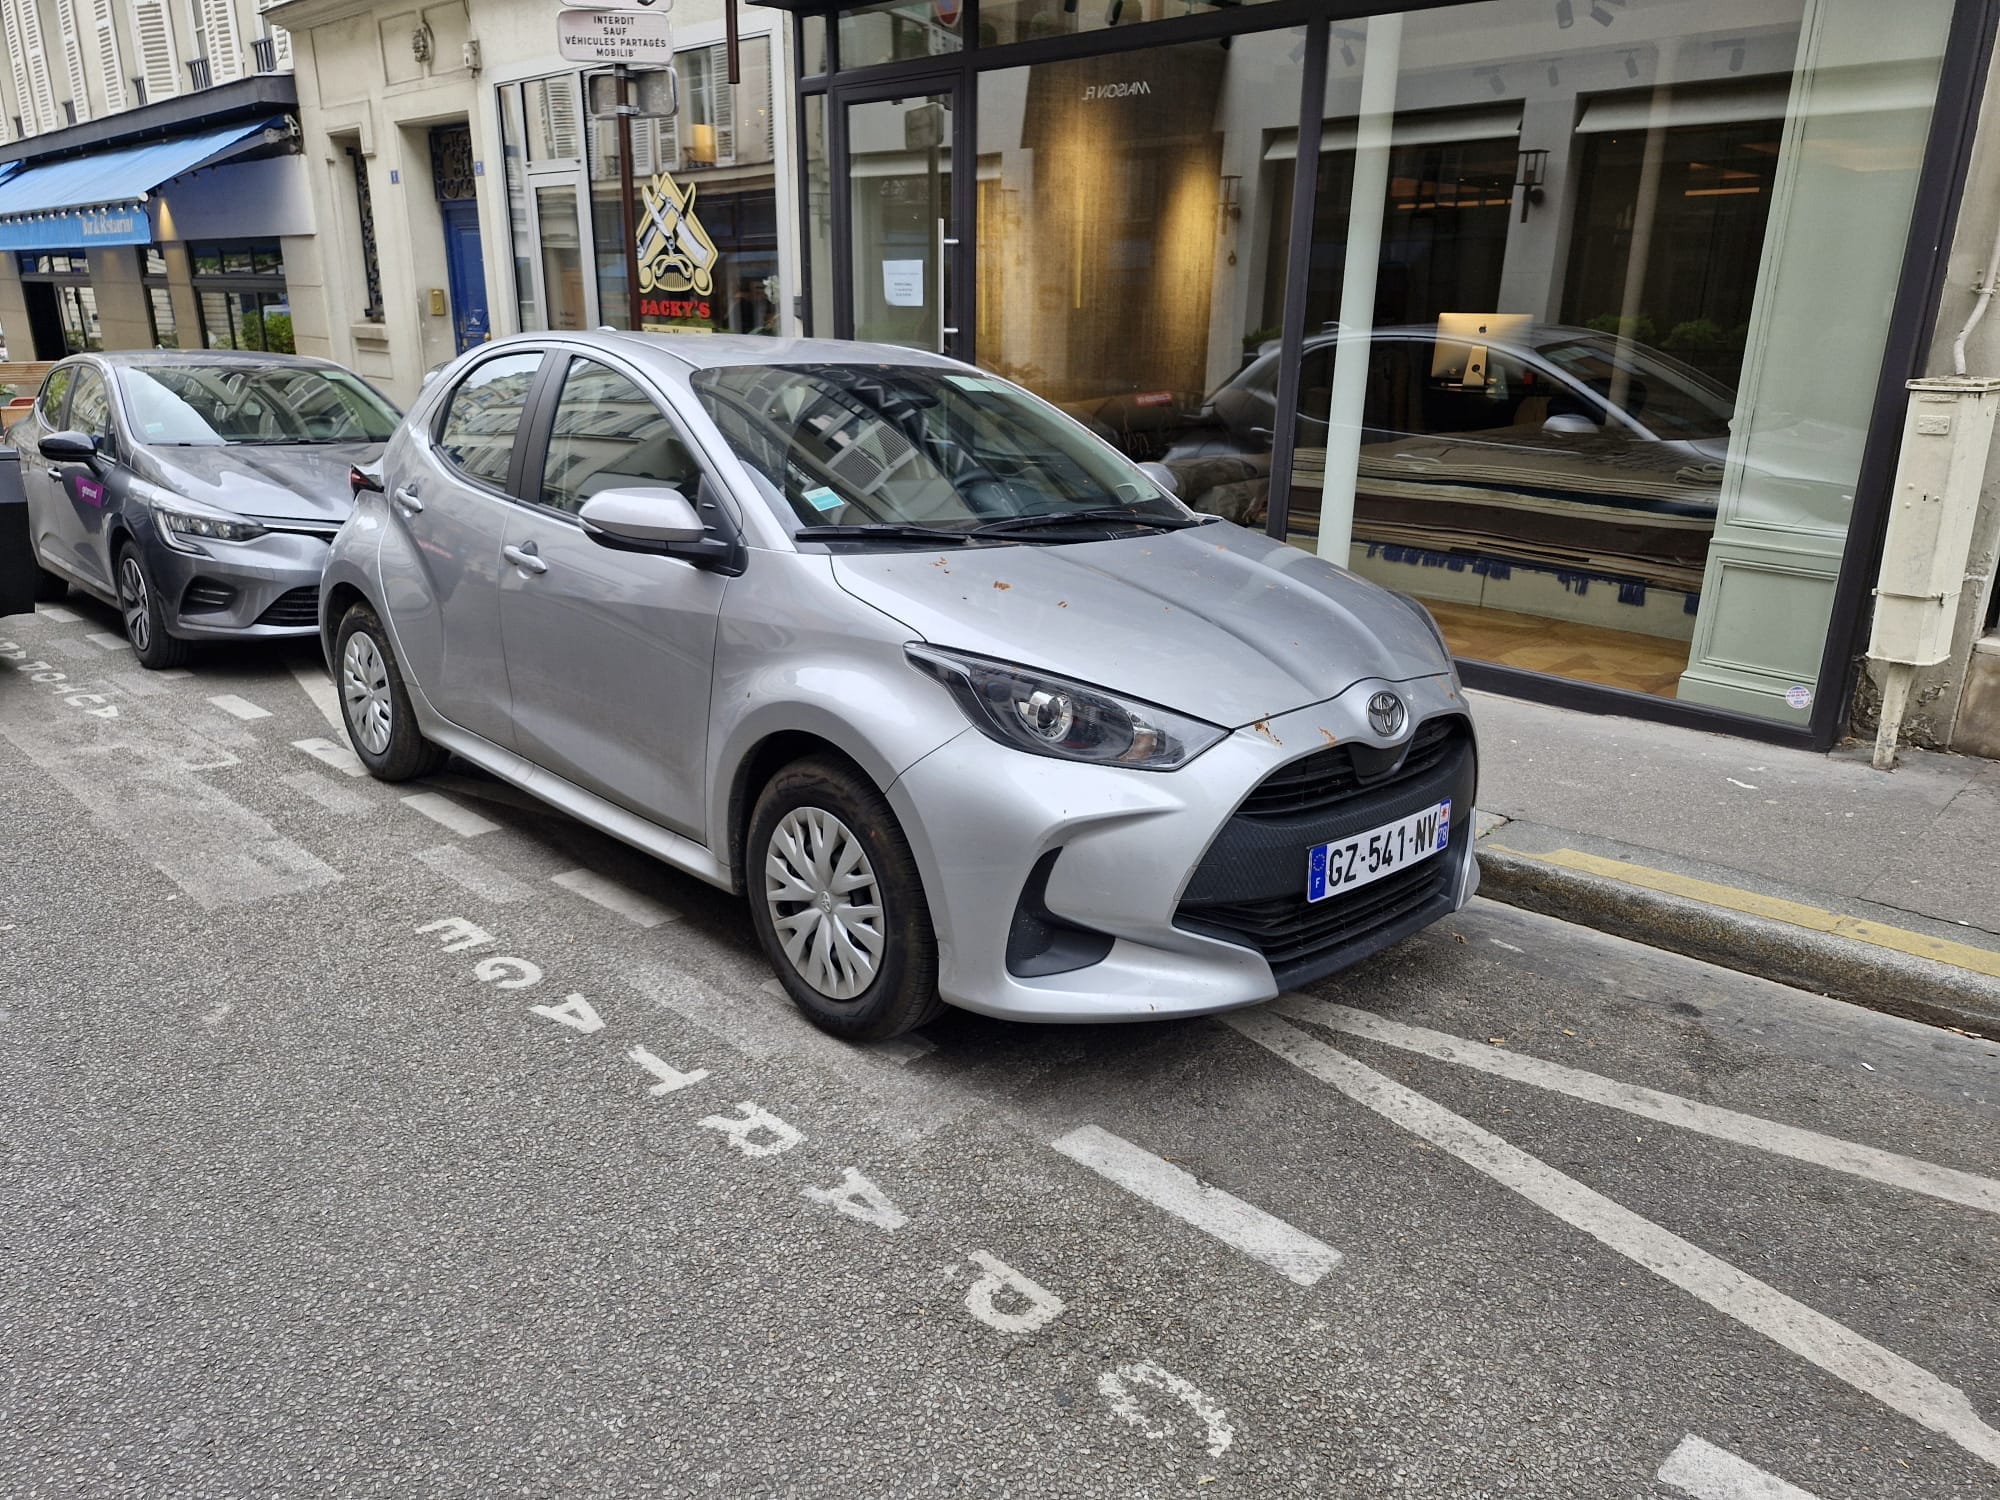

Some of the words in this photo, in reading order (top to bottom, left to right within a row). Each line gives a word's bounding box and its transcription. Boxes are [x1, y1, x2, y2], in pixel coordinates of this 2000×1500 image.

[593, 16, 635, 25] INTERDIT
[603, 27, 627, 36] SAUF
[565, 35, 616, 46] VÉHICULES
[620, 38, 666, 48] PARTAGÉS
[641, 299, 711, 319] JACKY'S
[1315, 877, 1321, 889] F
[1328, 812, 1438, 887] GZ-541-NV
